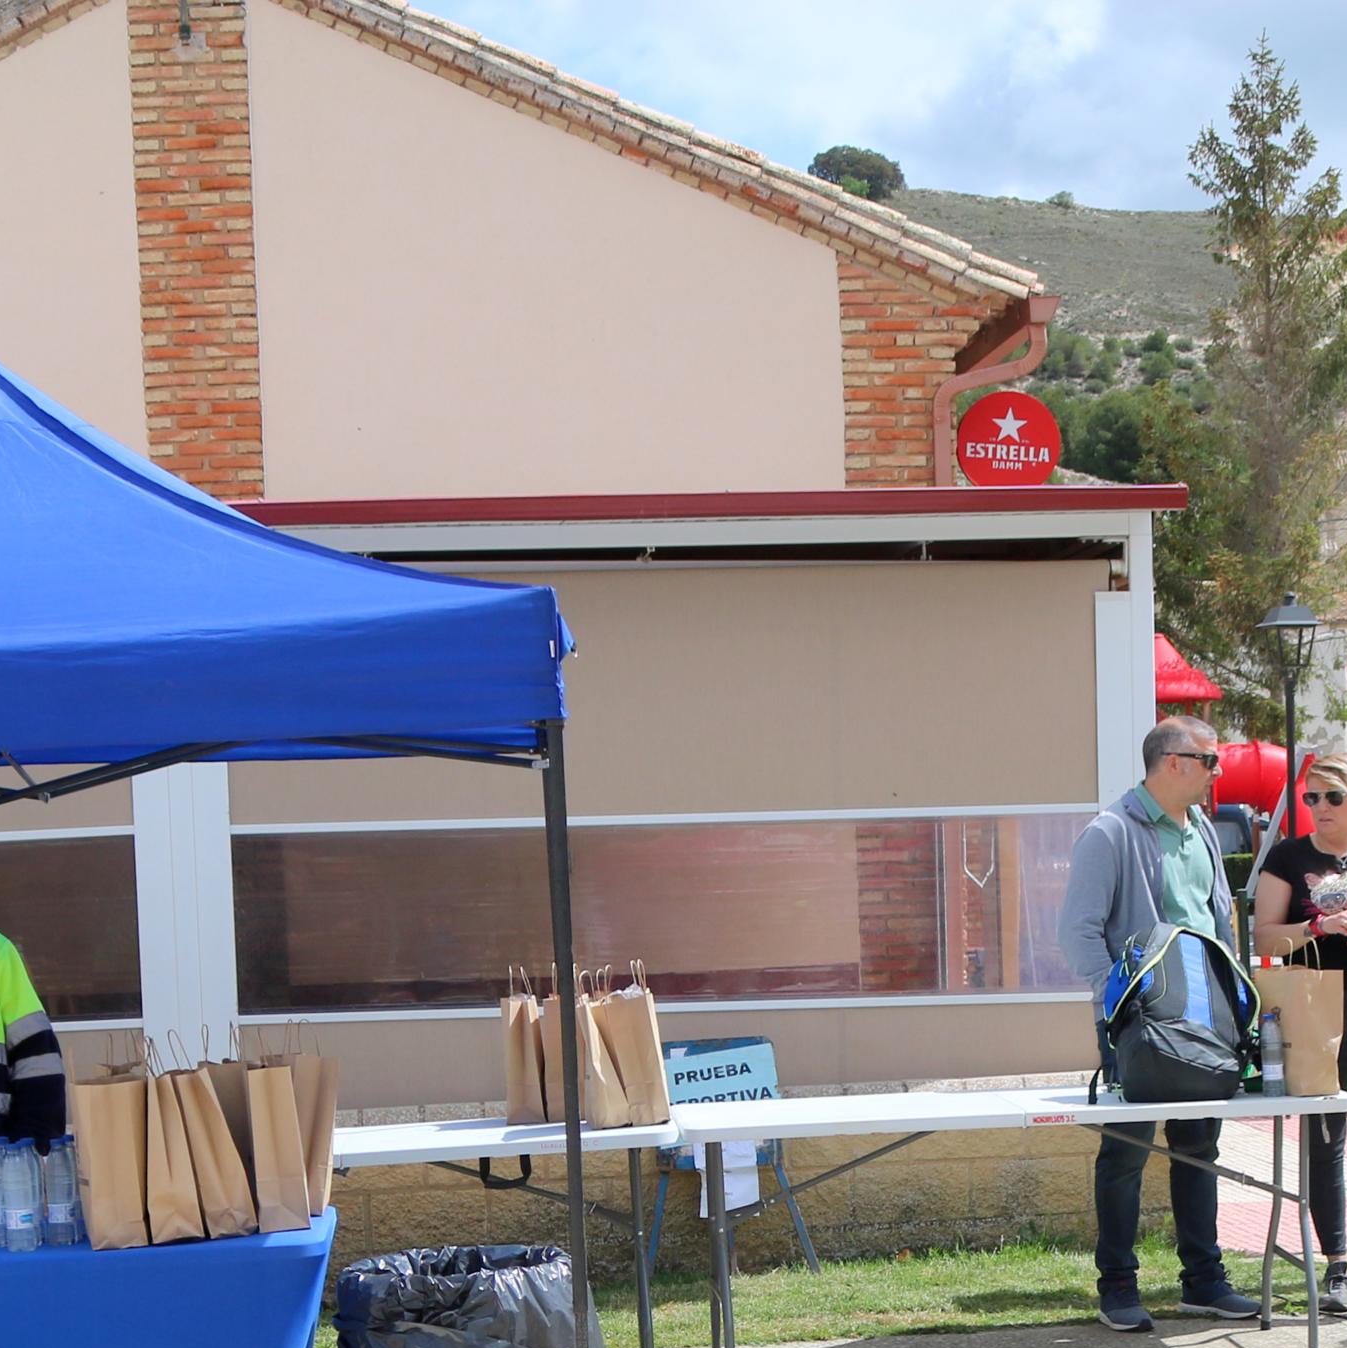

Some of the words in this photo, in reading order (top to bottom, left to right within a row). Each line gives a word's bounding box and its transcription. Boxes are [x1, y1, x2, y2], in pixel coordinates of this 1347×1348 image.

[965, 441, 1051, 464] ESTRELLA
[991, 460, 1023, 471] DAMM
[673, 1062, 752, 1086] PRUEBA
